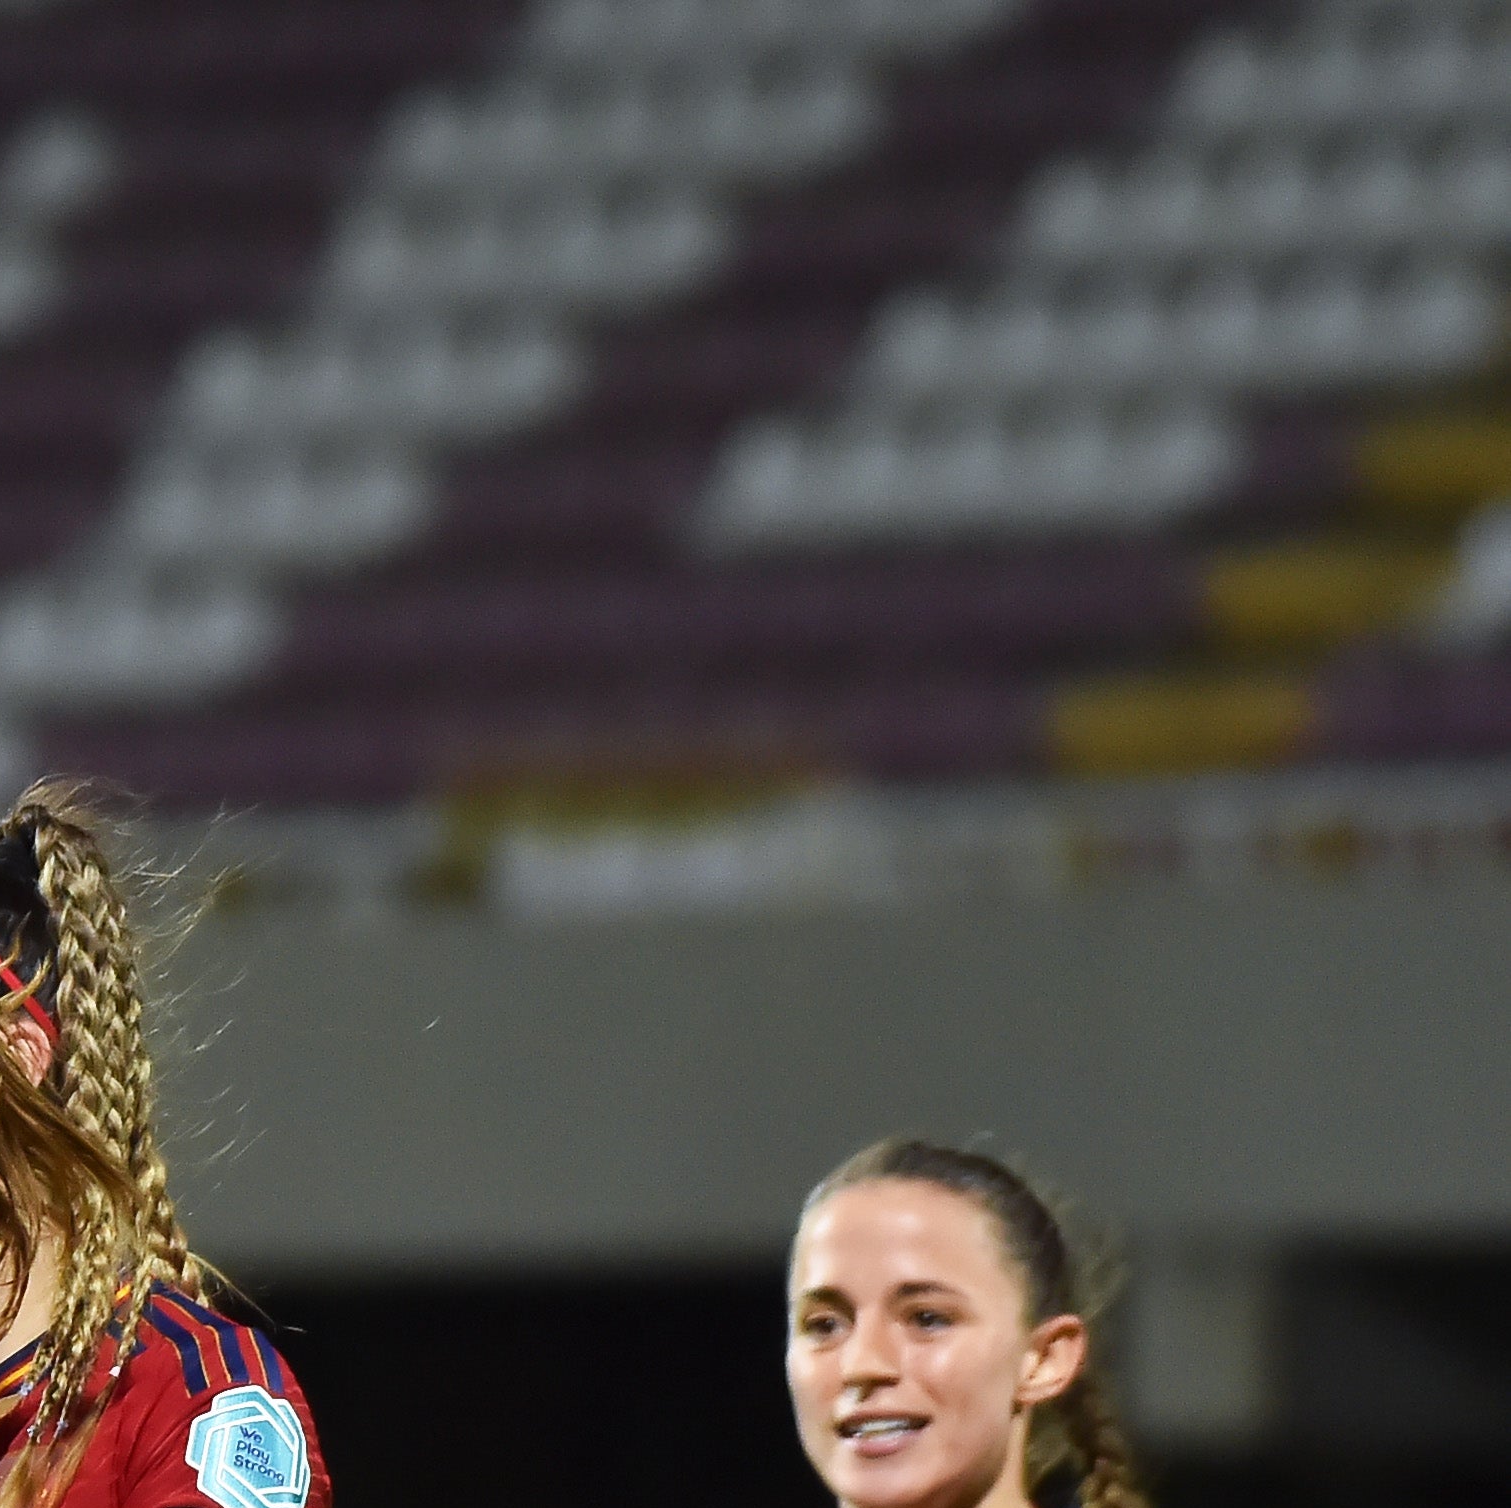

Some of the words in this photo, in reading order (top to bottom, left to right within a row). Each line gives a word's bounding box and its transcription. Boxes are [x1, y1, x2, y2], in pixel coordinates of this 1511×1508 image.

[240, 1426, 262, 1443] We
[237, 1440, 270, 1464] Play
[234, 1455, 285, 1486] Strong
